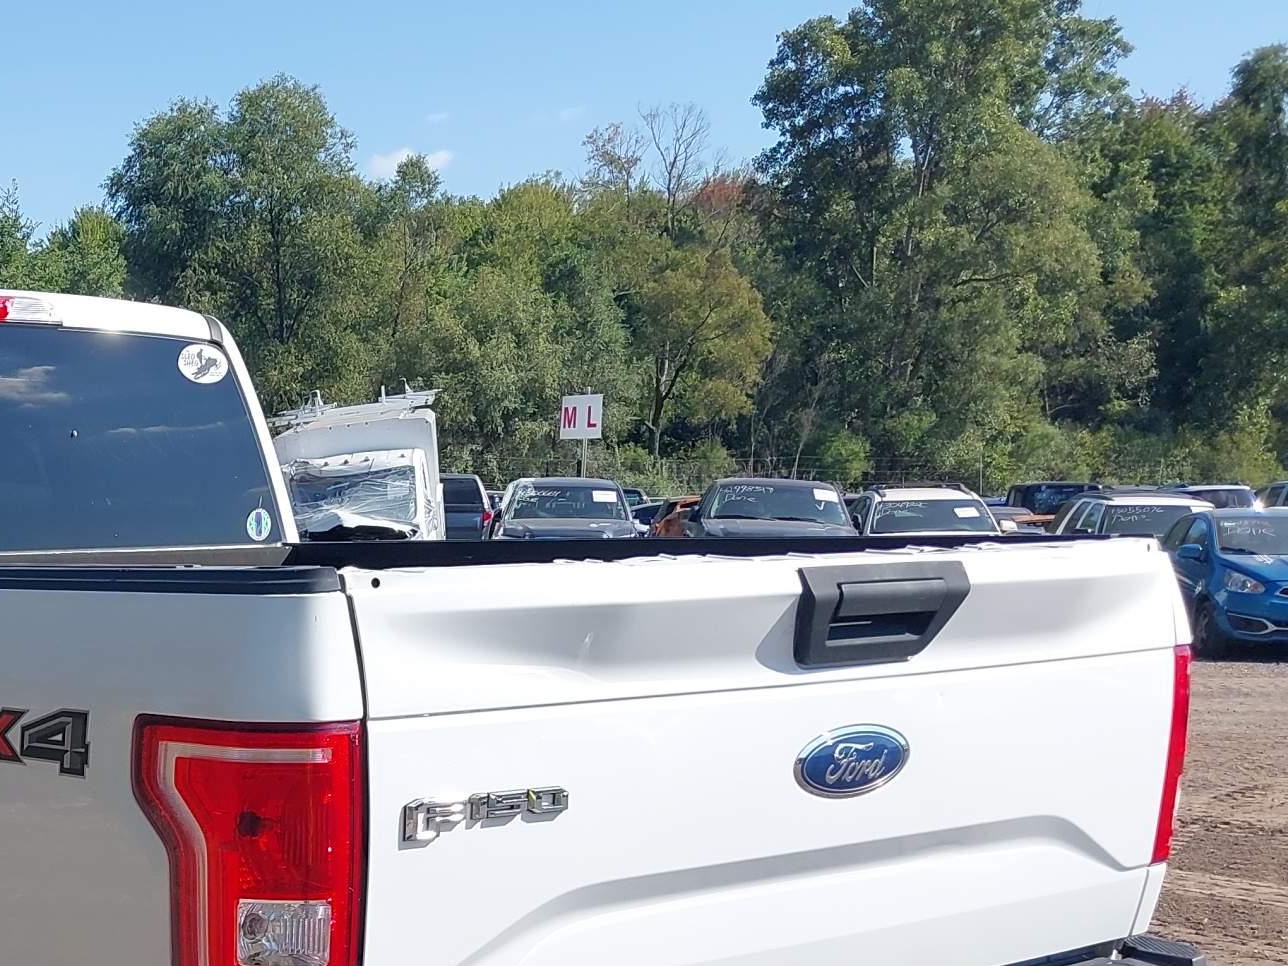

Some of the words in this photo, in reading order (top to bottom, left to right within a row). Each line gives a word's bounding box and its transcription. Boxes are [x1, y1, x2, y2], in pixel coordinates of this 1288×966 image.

[563, 406, 577, 429] M
[587, 405, 597, 428] L
[825, 742, 888, 784] Ford
